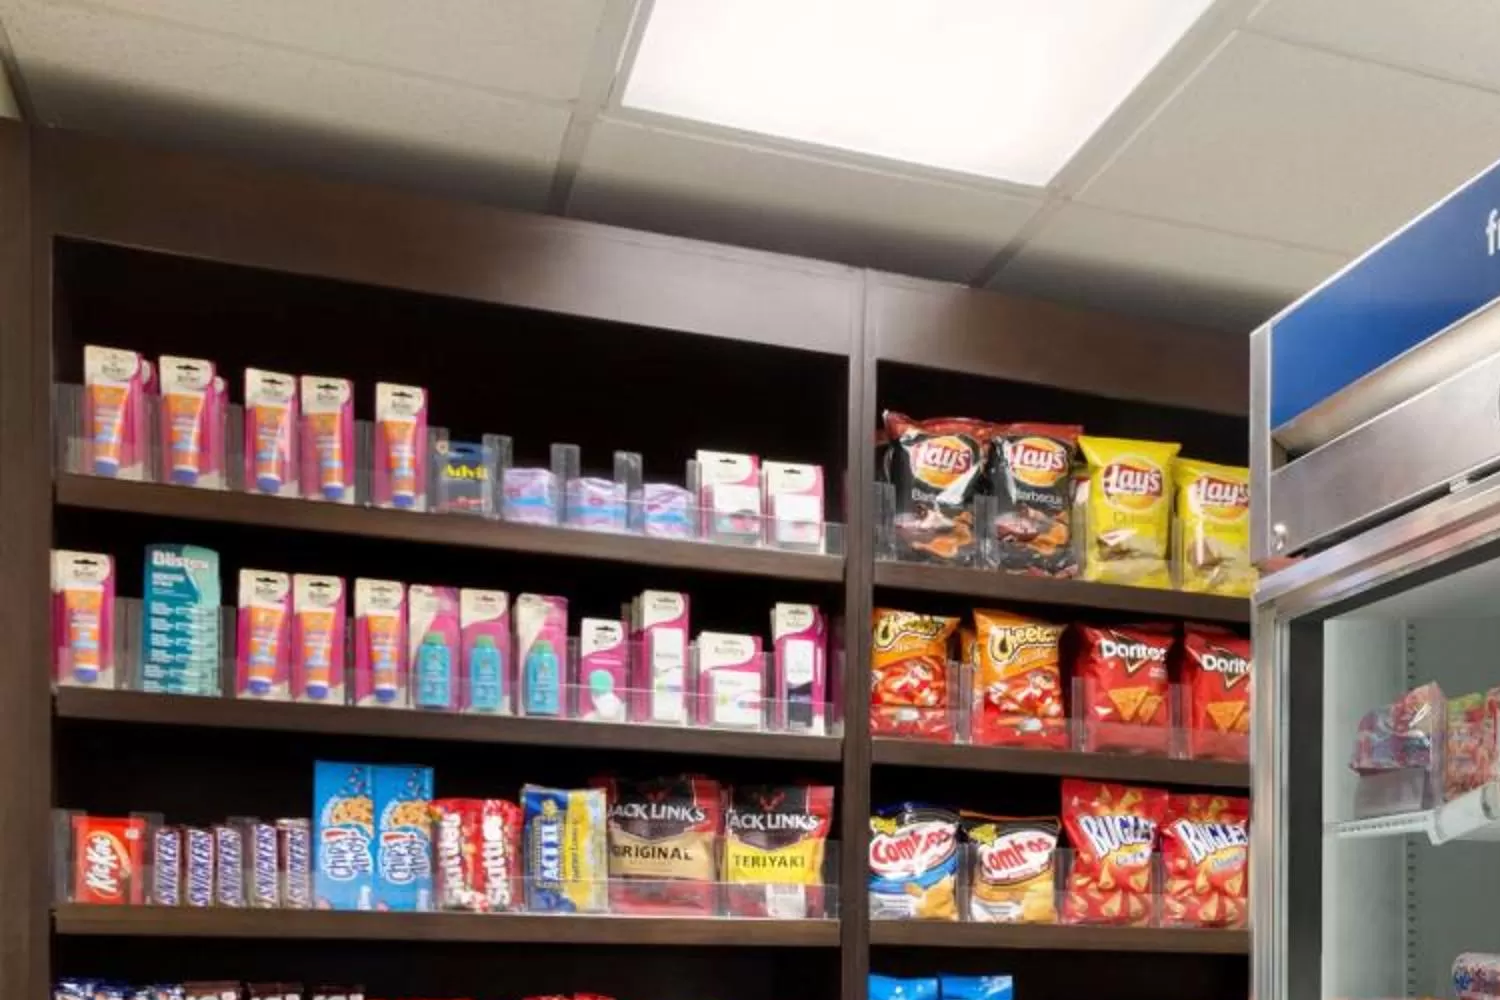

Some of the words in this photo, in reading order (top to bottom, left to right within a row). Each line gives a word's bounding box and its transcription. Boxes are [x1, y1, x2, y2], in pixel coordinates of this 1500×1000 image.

[1103, 463, 1163, 497] Lay's
[1202, 651, 1250, 673] Dorit
[611, 844, 693, 861] ORIGINAL
[734, 853, 806, 869] TERIYAKI
